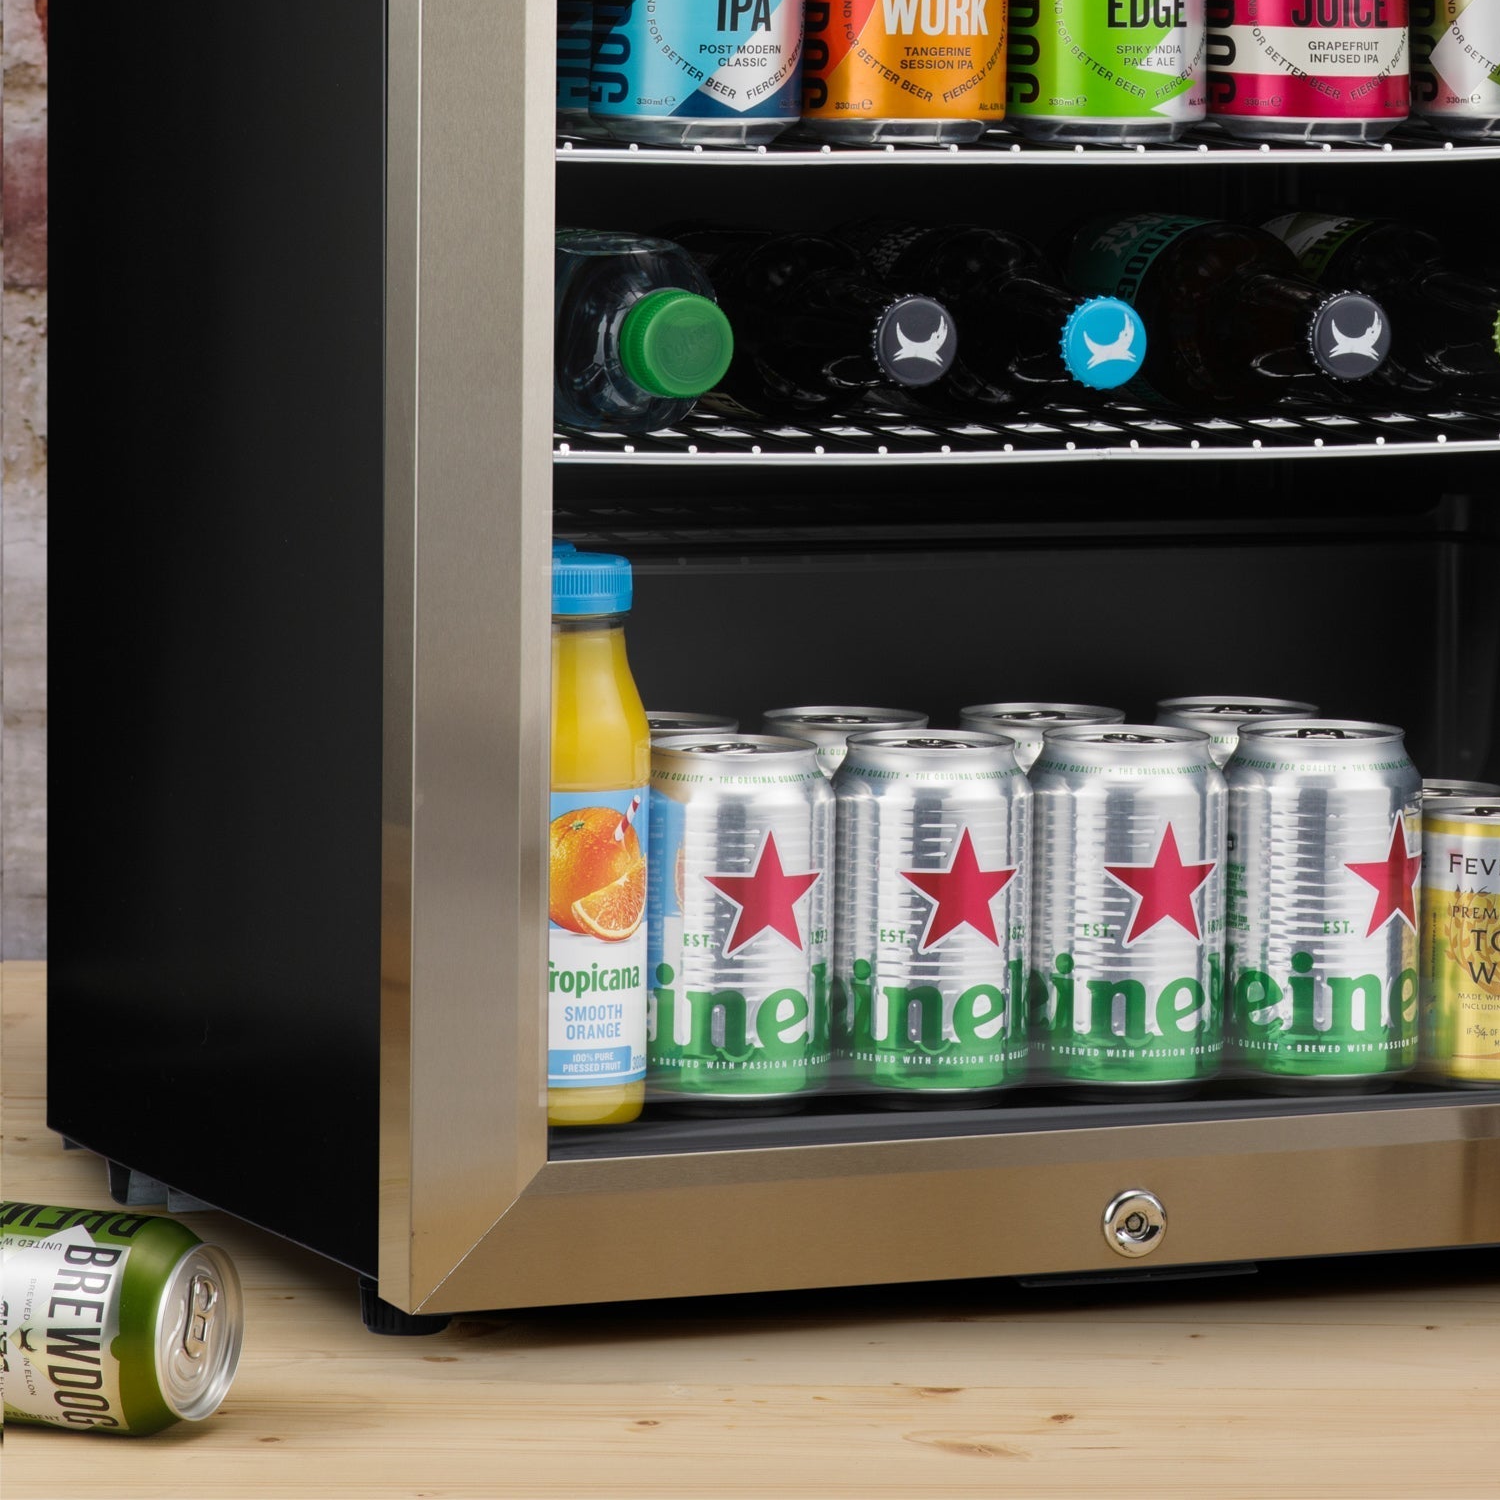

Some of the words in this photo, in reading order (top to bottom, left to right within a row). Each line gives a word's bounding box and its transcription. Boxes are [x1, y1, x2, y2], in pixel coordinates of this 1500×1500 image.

[699, 44, 733, 54] POST
[736, 44, 781, 55] MODERN
[904, 46, 972, 56] TANGERINE
[1116, 45, 1151, 55] SPIKY
[1155, 44, 1182, 55] INDIA
[1307, 40, 1379, 51] GRAPEFRUIT
[718, 57, 767, 67] CLASSIC
[1124, 57, 1153, 67] PALE
[1156, 56, 1175, 67] ALE
[1310, 53, 1360, 63] INFUSED
[1363, 53, 1379, 63] IPA
[900, 59, 954, 70] SESSION
[957, 60, 974, 70] IPA
[719, 776, 733, 784] THE
[737, 776, 776, 784] ORIGINAL
[778, 774, 805, 784] QUALITY
[1323, 921, 1354, 934] EST.
[683, 933, 715, 948] EST.
[1458, 992, 1482, 1000] MADE
[565, 1004, 623, 1022] SMOOTH
[566, 1022, 621, 1040] ORANGE
[1297, 1044, 1340, 1053] BREWED
[1347, 1043, 1373, 1052] WITH
[1378, 1039, 1410, 1051] PASSION
[572, 1053, 593, 1062] 100%
[594, 1051, 614, 1062] PURE
[903, 1056, 931, 1065] WITH
[939, 1055, 984, 1064] PASSION
[563, 1063, 601, 1073] PRESSED
[600, 1061, 621, 1071] FRUIT
[660, 1057, 699, 1069] BREWED
[706, 1061, 735, 1070] WITH
[742, 1060, 787, 1069] PASSION
[793, 1058, 808, 1067] FOR
[46, 1244, 123, 1427] BREWDOG
